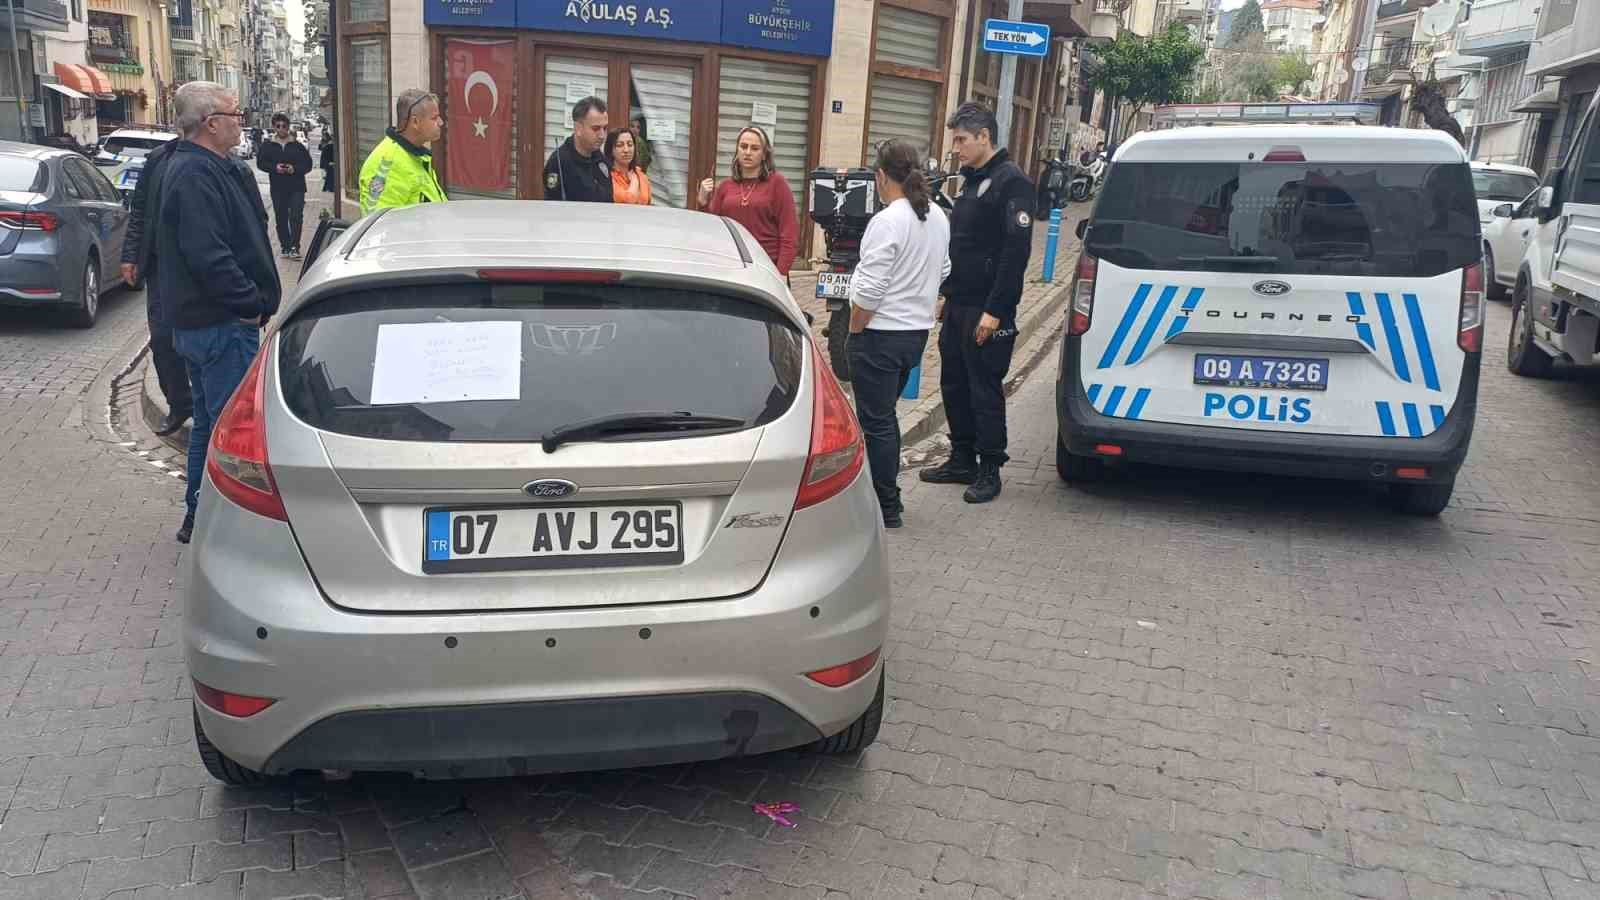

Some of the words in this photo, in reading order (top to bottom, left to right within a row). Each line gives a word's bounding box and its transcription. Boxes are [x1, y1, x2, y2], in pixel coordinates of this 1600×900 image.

[644, 7, 674, 29] A.Ş.
[748, 12, 811, 32] BÜYÜKŞEHİR
[993, 31, 1009, 41] TEK
[1011, 32, 1028, 43] YÖN
[820, 274, 833, 284] 09
[1180, 308, 1361, 323] TOURNEO
[1203, 358, 1232, 379] 09
[1238, 360, 1254, 380] A
[1262, 361, 1321, 383] 7326
[533, 482, 568, 498] Ford
[452, 514, 499, 556] 07
[532, 511, 599, 553] AVJ
[610, 509, 675, 550] 295
[431, 540, 448, 551] TR
